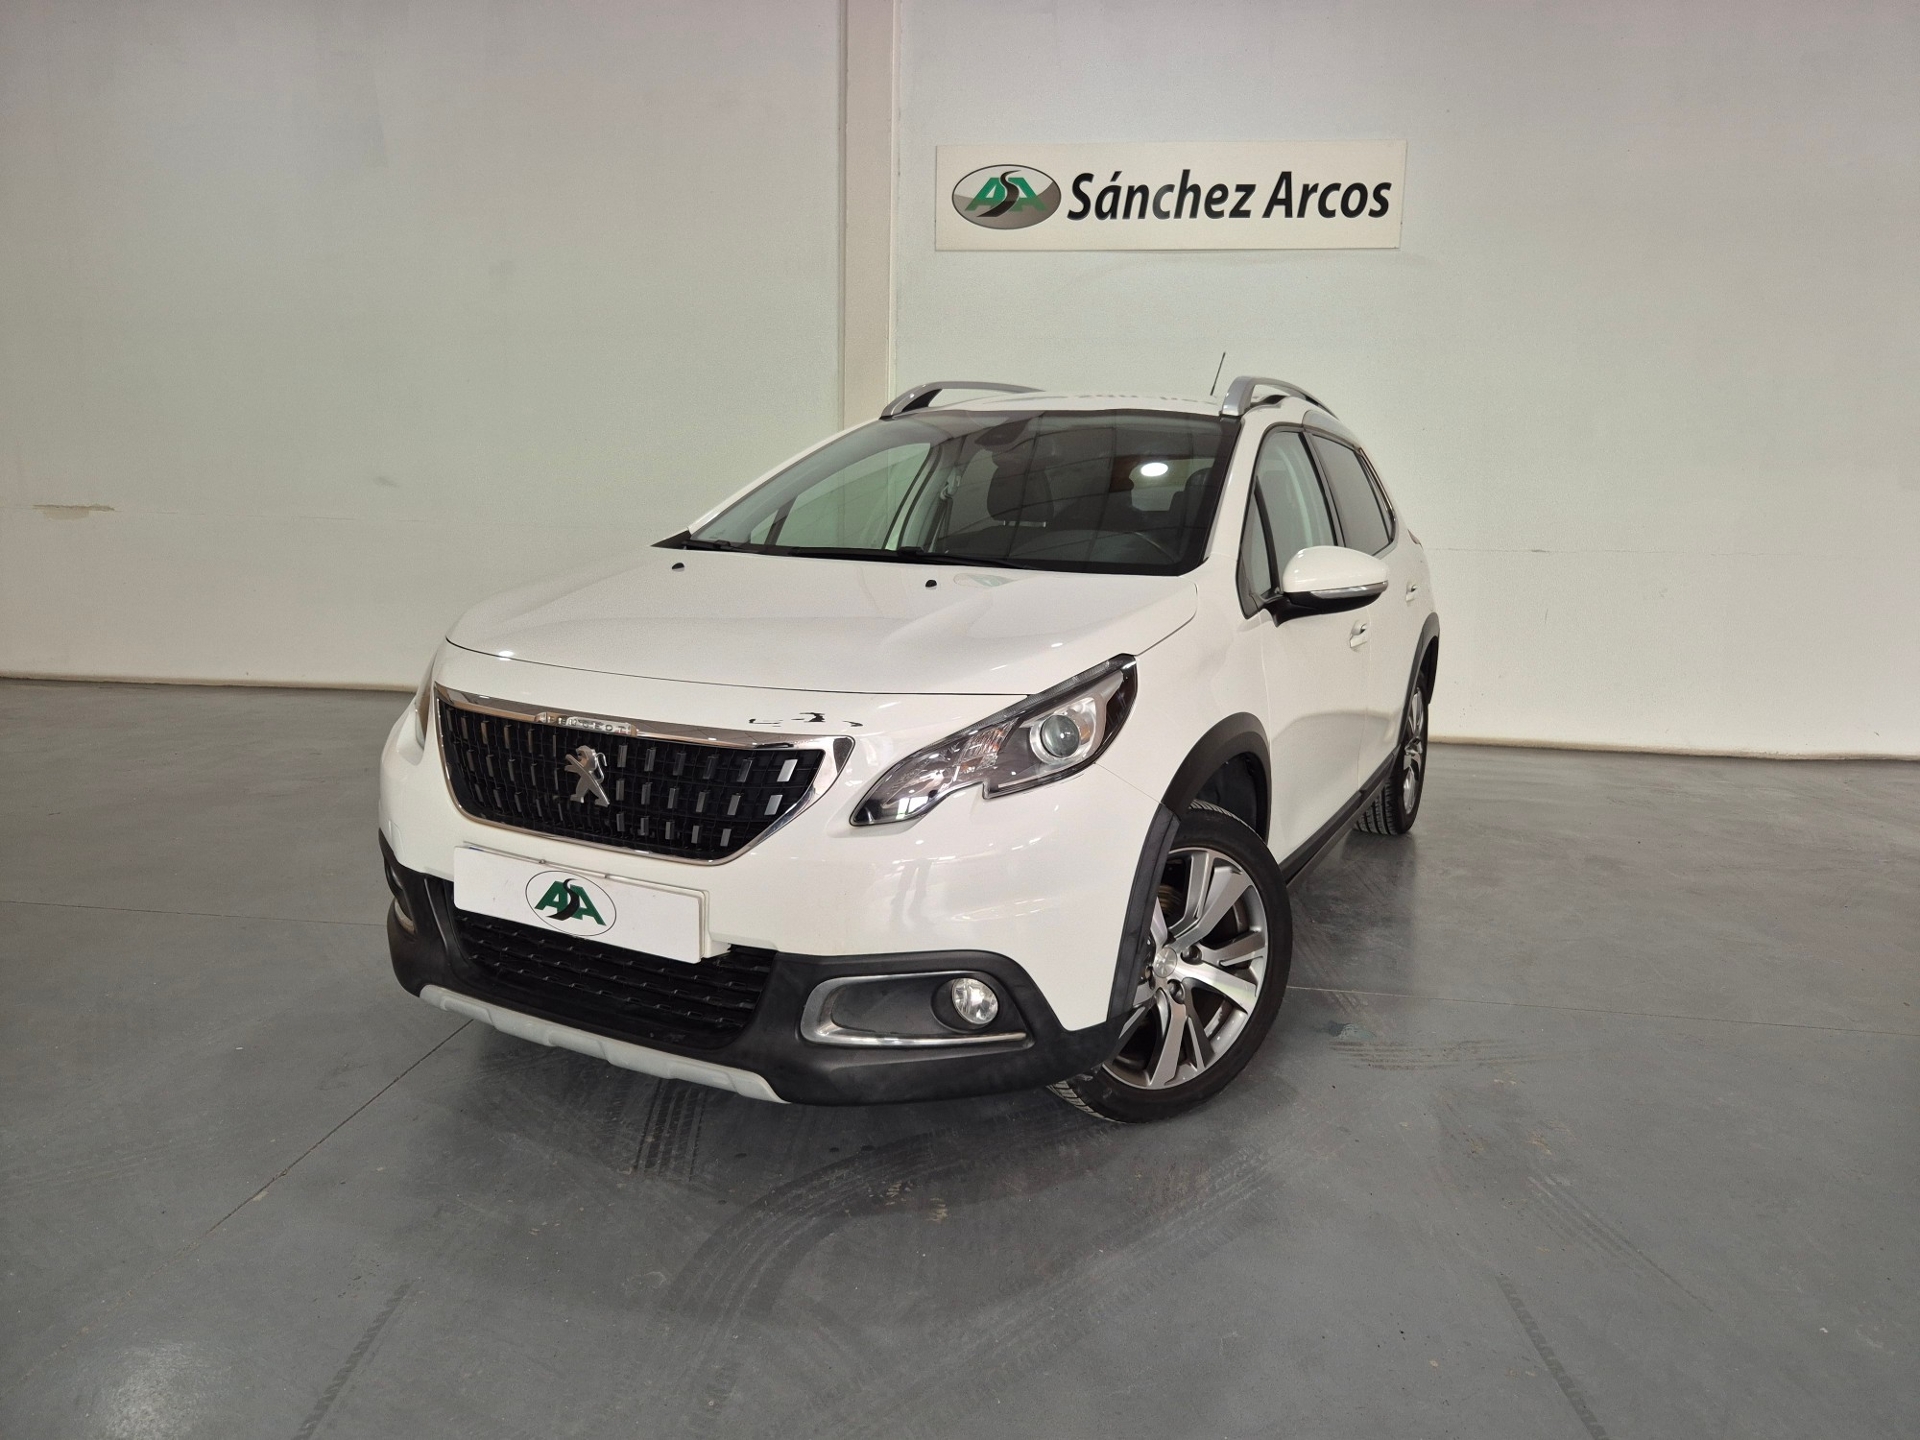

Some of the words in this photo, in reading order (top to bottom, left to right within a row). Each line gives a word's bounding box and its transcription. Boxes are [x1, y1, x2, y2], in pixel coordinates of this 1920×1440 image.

[964, 170, 1046, 217] ASA
[1066, 169, 1256, 220] Sánchez
[1262, 171, 1392, 219] Arcos
[534, 878, 607, 926] ASA
